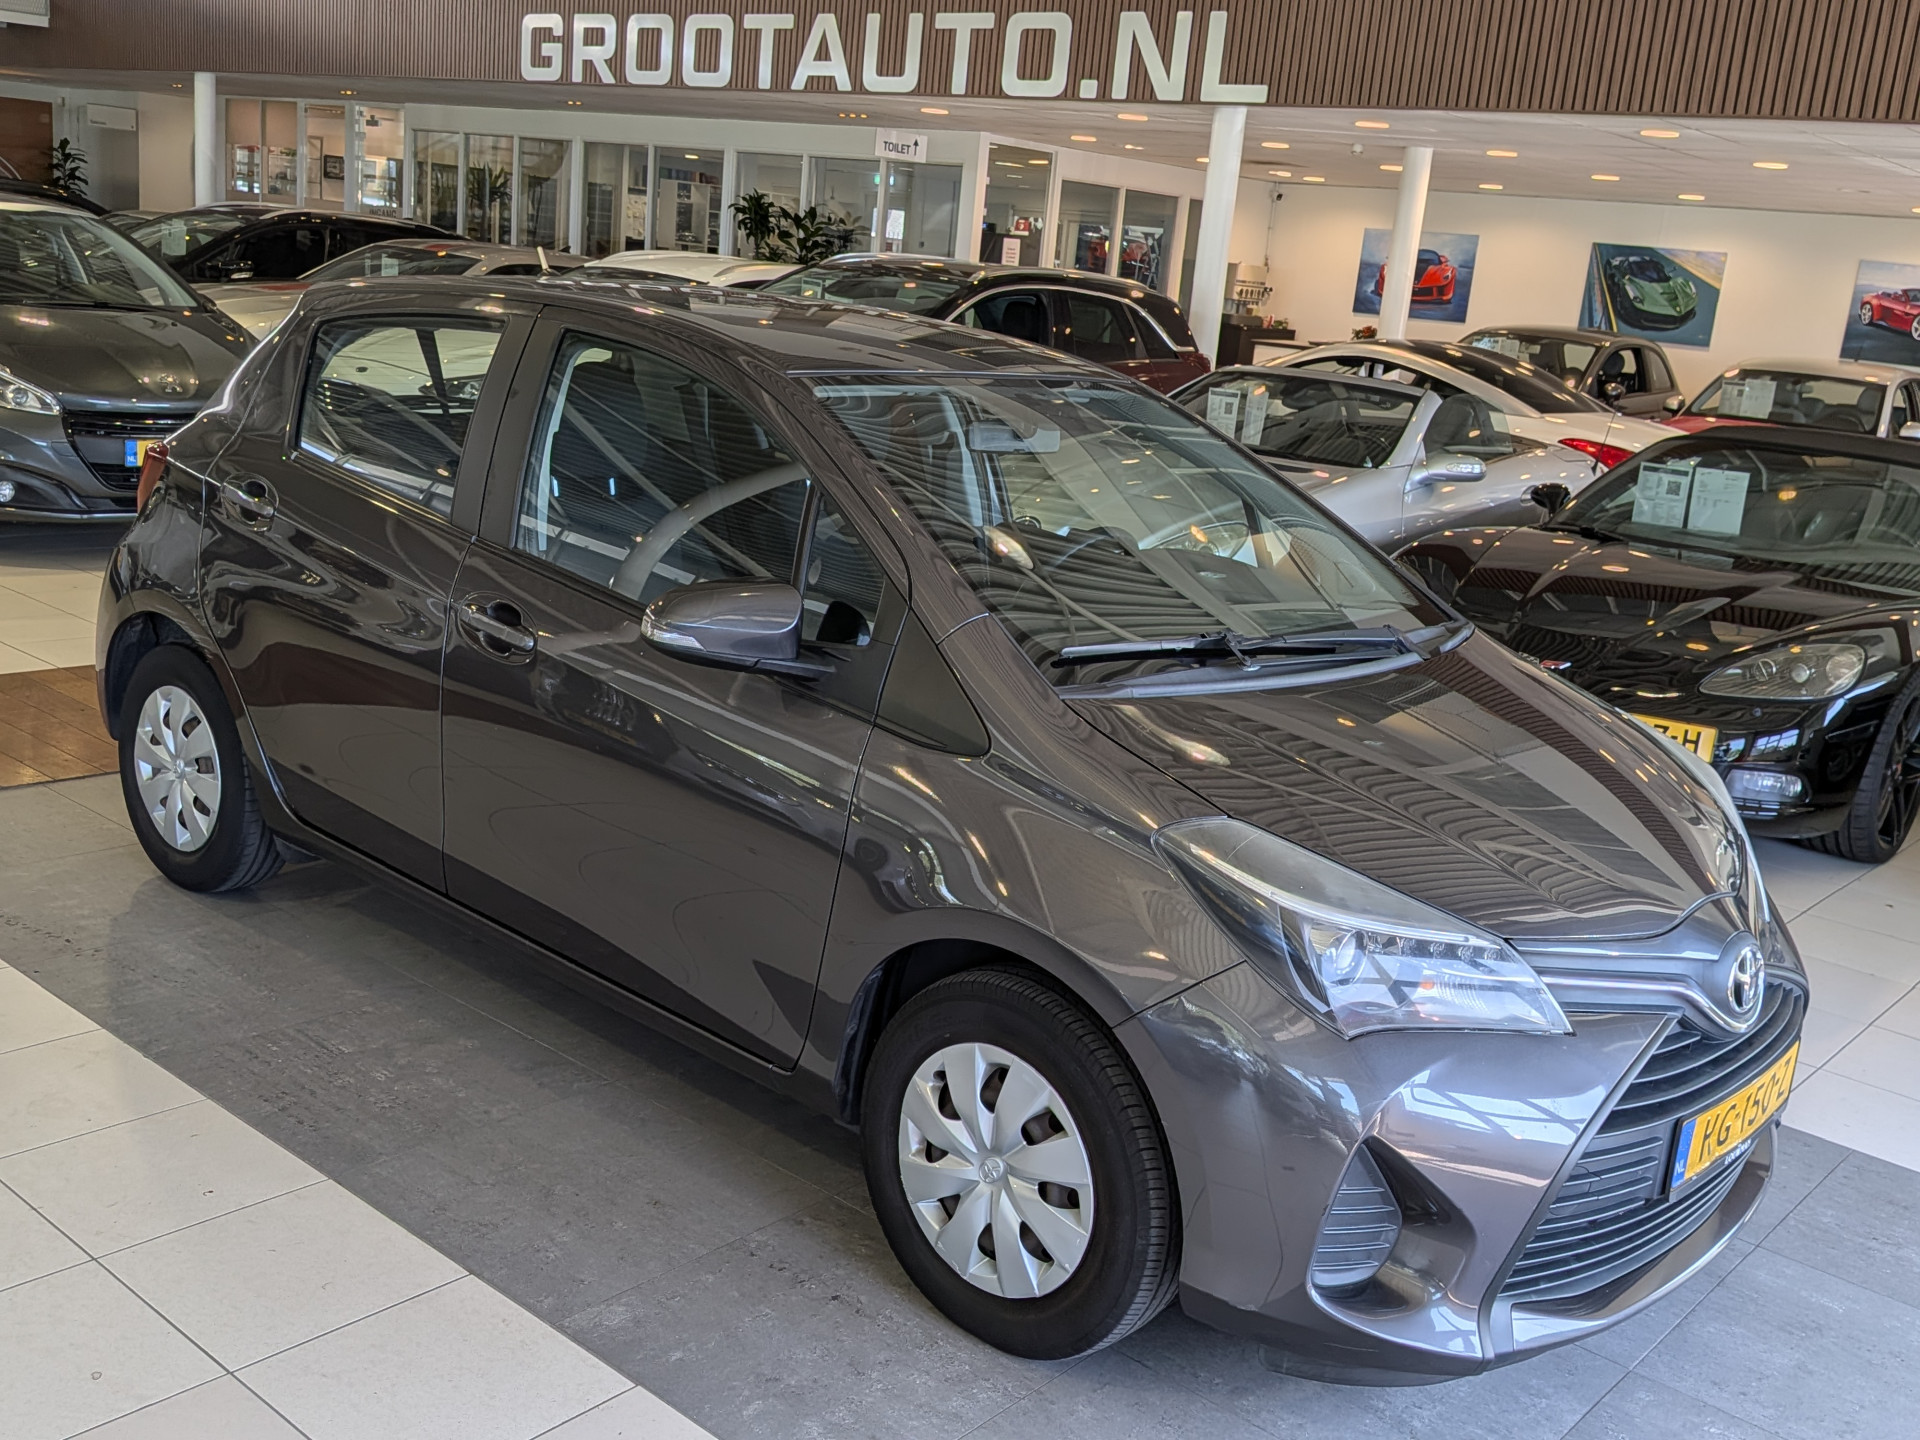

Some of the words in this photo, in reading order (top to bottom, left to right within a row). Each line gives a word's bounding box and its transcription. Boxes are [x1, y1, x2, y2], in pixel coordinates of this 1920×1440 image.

[520, 11, 1268, 103] GROOTAUTO.NL
[883, 141, 911, 155] TOILET
[127, 455, 136, 463] NL
[1674, 1159, 1685, 1177] NL
